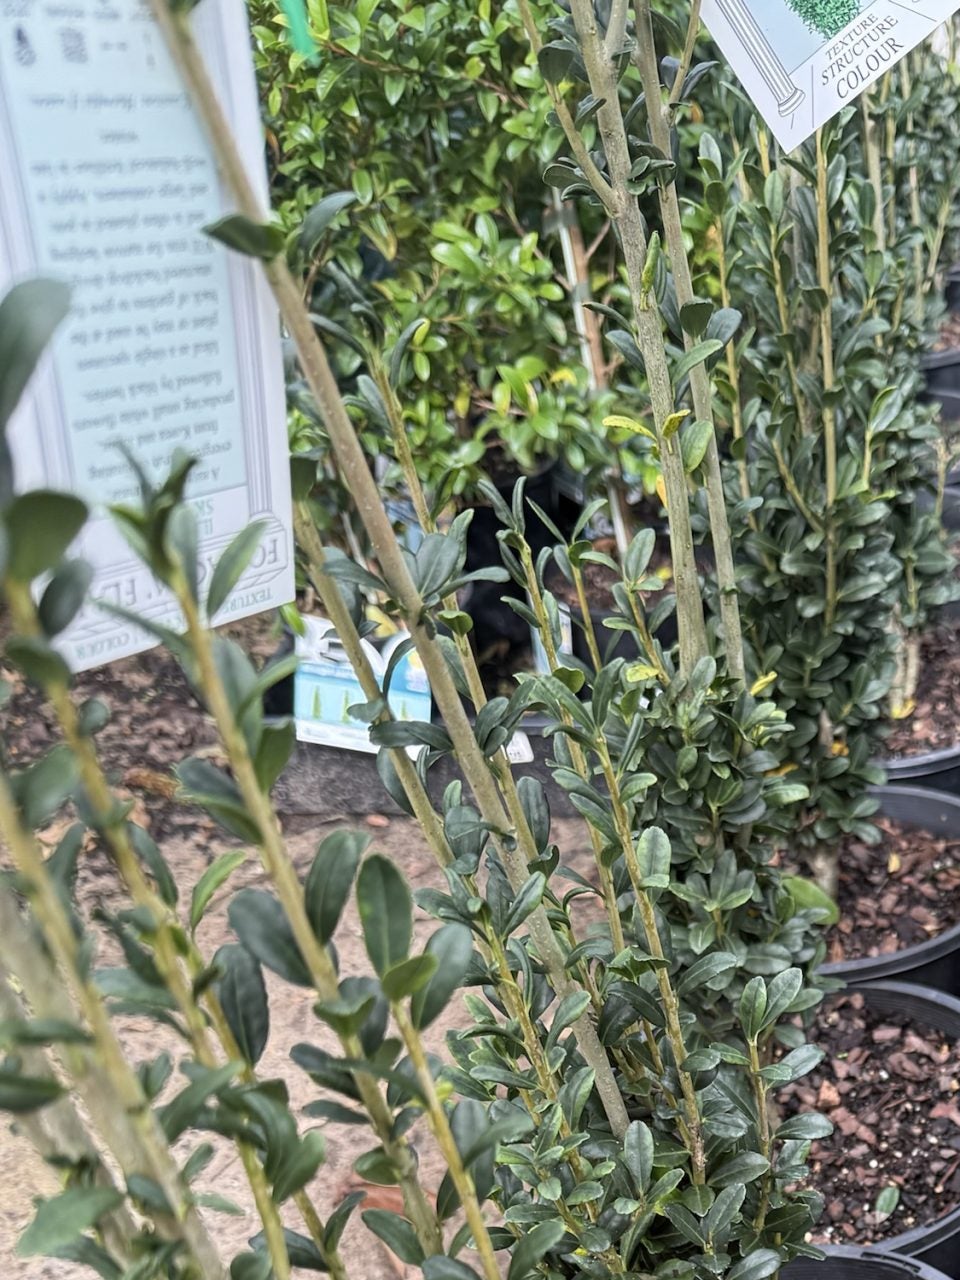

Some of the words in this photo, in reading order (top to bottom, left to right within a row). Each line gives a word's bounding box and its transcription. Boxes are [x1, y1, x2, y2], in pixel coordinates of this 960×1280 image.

[821, 15, 898, 86] STRUCTURE
[825, 13, 879, 60] TEXTURE
[836, 37, 904, 99] COLOUR
[76, 632, 130, 660] COLOUR
